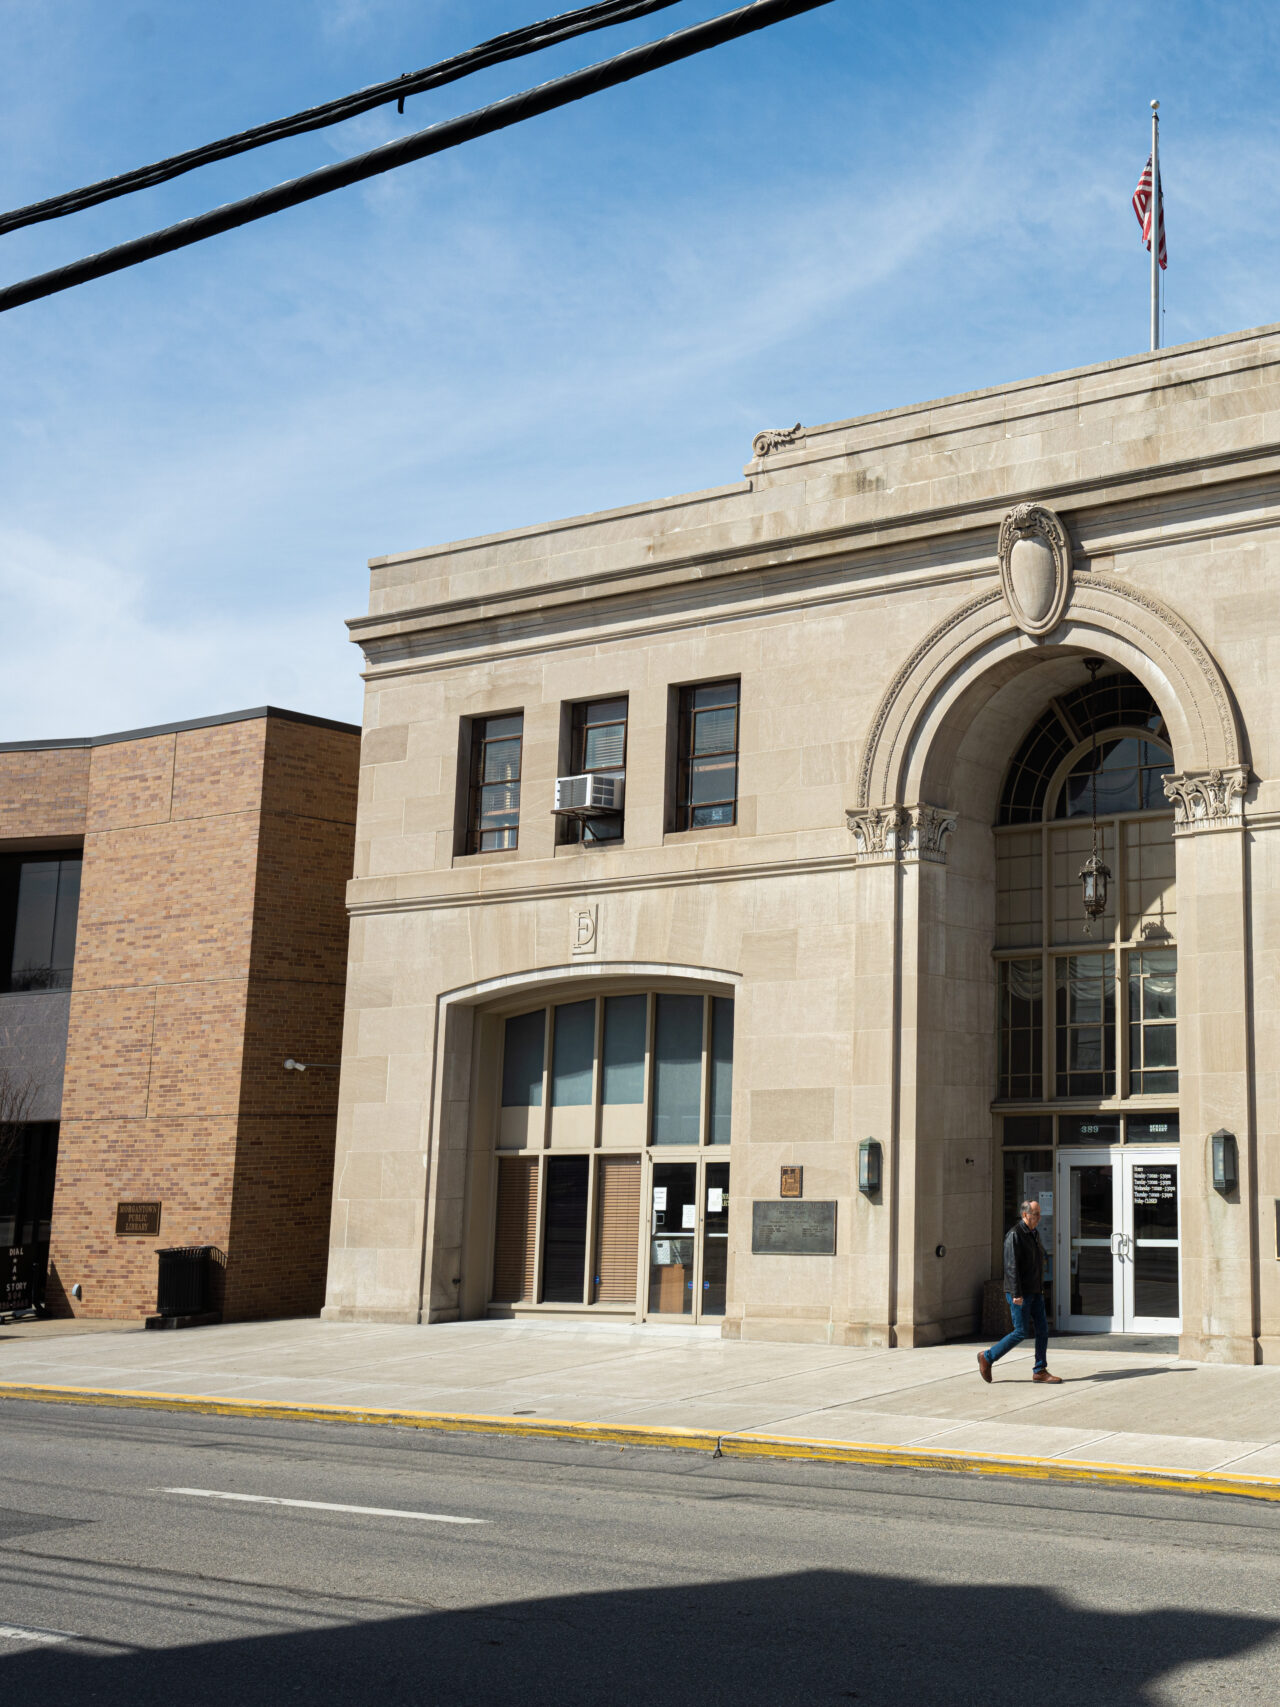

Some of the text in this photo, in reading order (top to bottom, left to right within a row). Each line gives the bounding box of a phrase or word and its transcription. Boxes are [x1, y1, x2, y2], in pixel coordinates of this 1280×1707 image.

[1081, 1125, 1099, 1133] 389
[128, 1213, 148, 1221] PUBLIC
[125, 1222, 148, 1231] LIBRARY
[9, 1248, 24, 1256] DIAL
[12, 1265, 17, 1273] A
[6, 1282, 27, 1291] STORY
